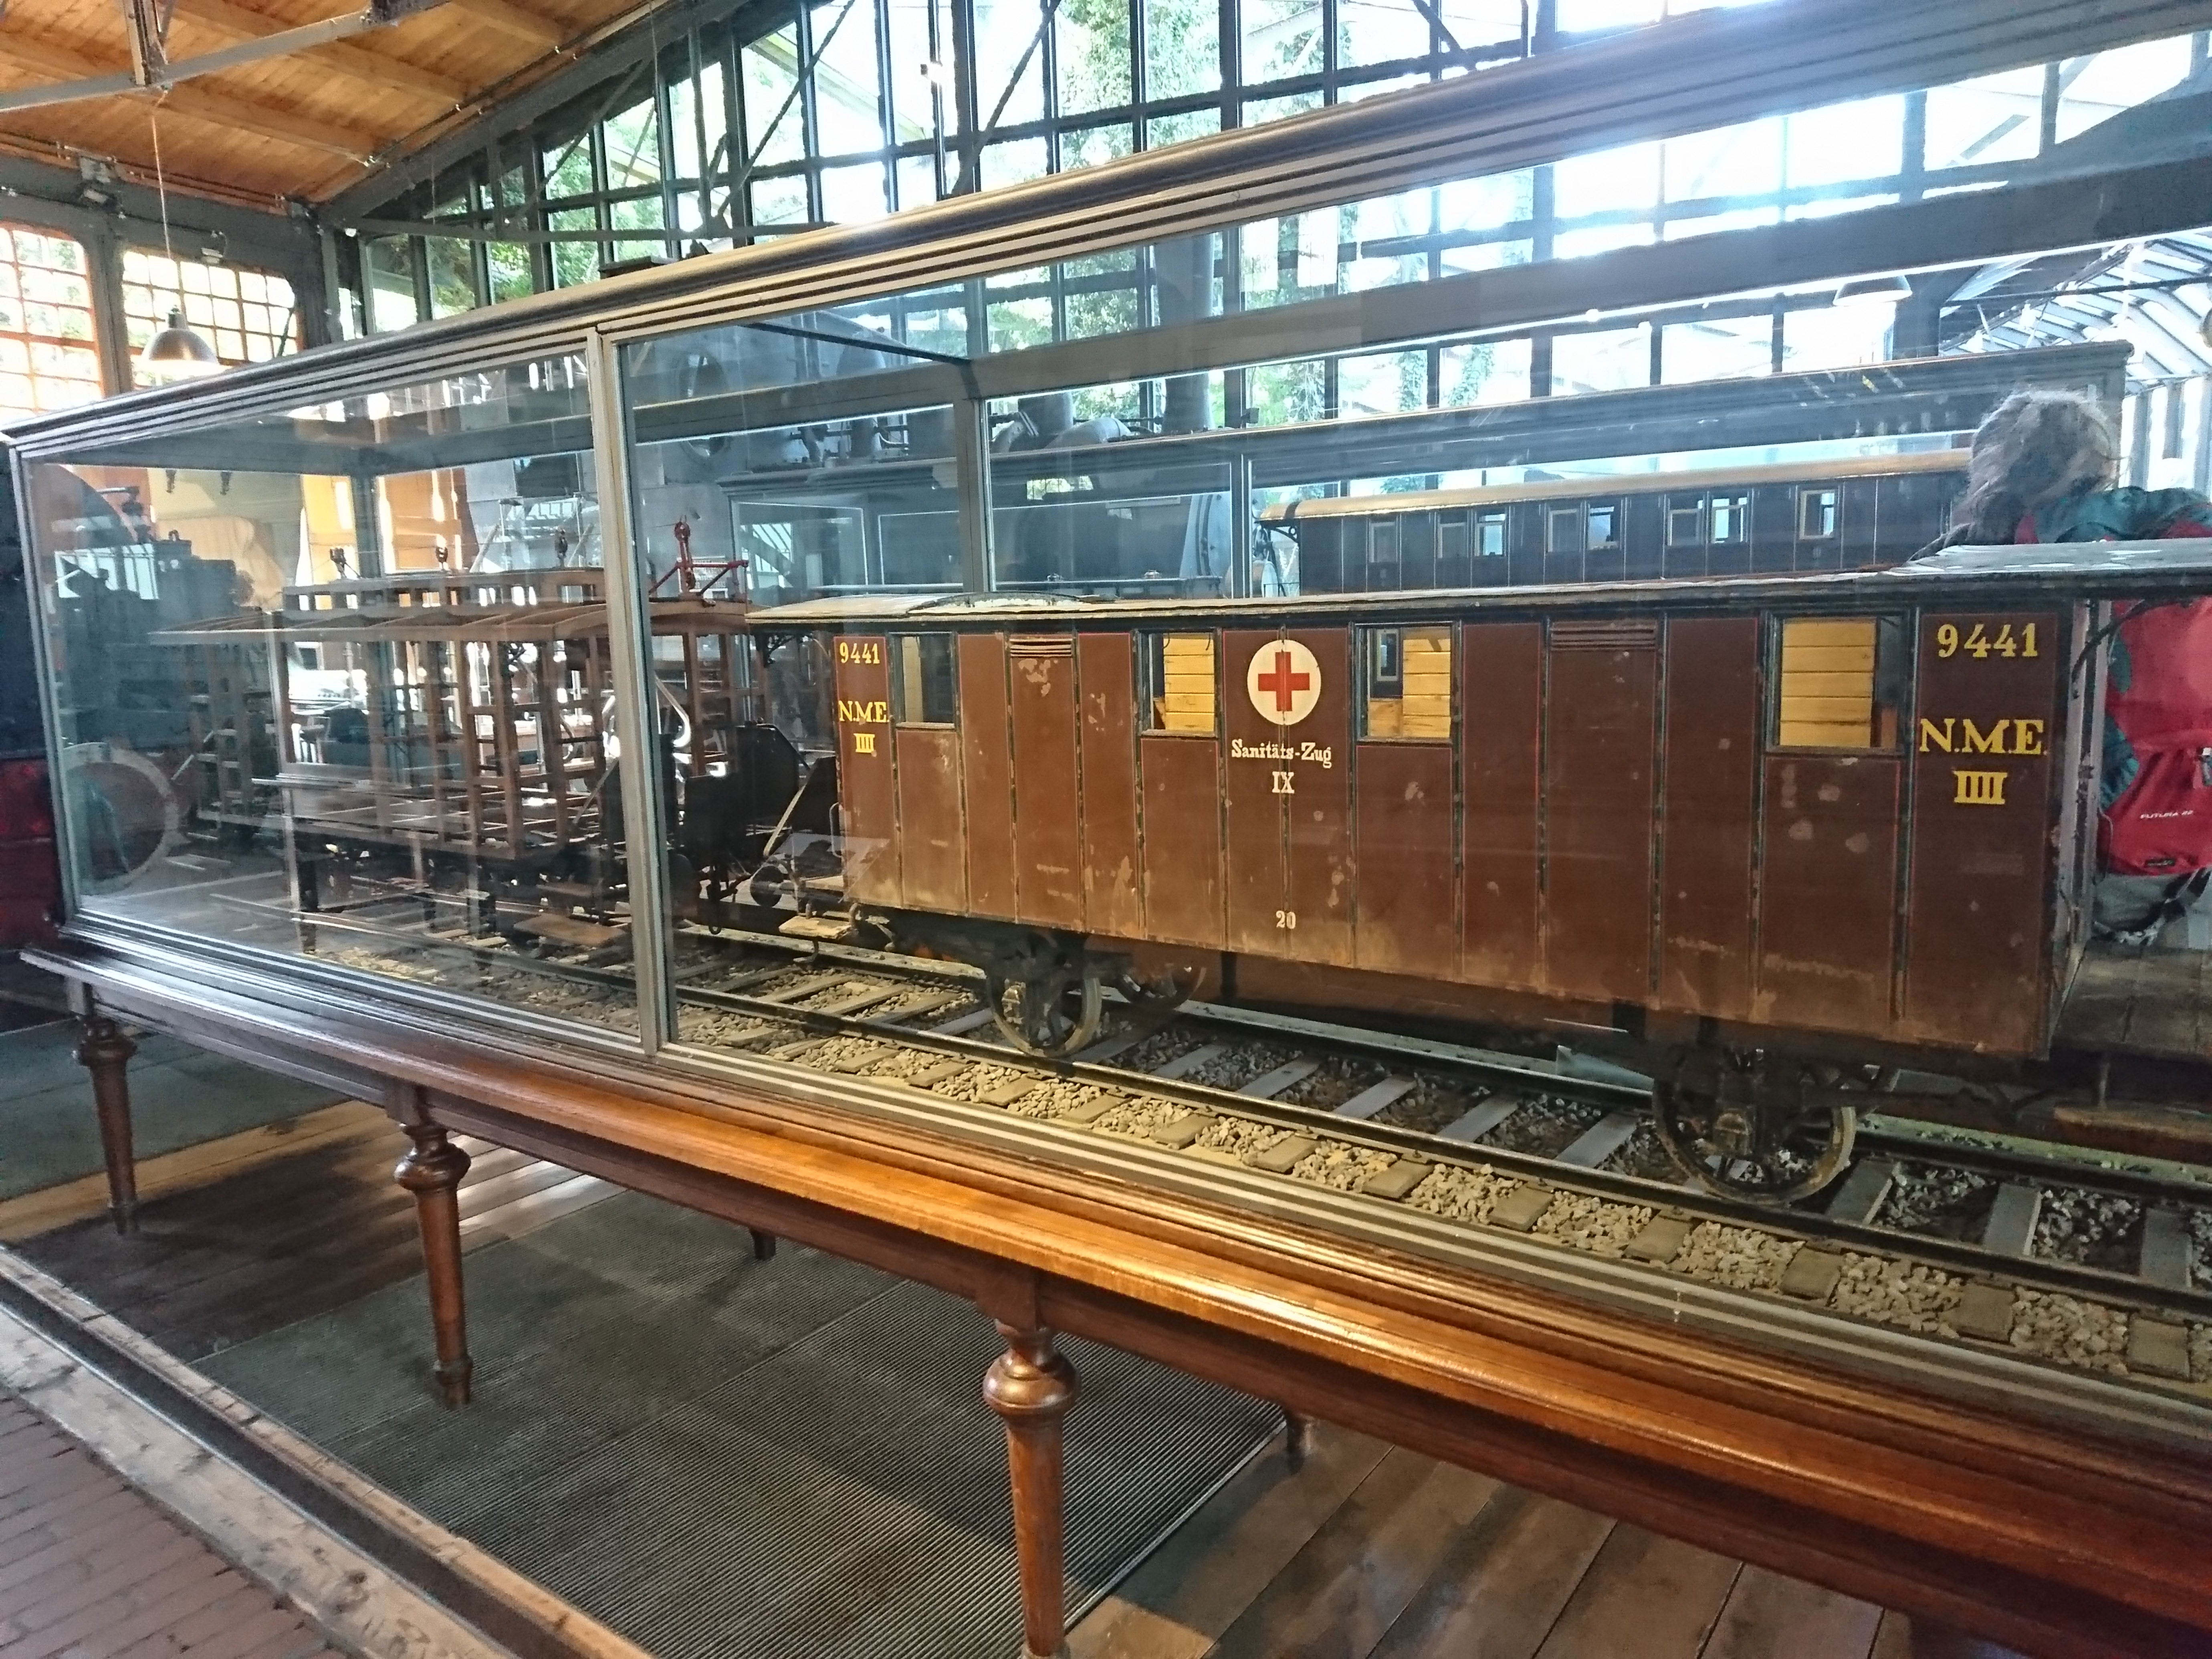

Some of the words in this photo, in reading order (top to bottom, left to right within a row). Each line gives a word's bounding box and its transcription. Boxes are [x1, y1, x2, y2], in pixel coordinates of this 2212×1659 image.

[1938, 623, 2037, 658] 9441
[840, 642, 880, 664] 9441
[1231, 739, 1332, 769] Sanitäts-Zug
[1272, 771, 1295, 794] IX
[1276, 910, 1296, 929] 20
